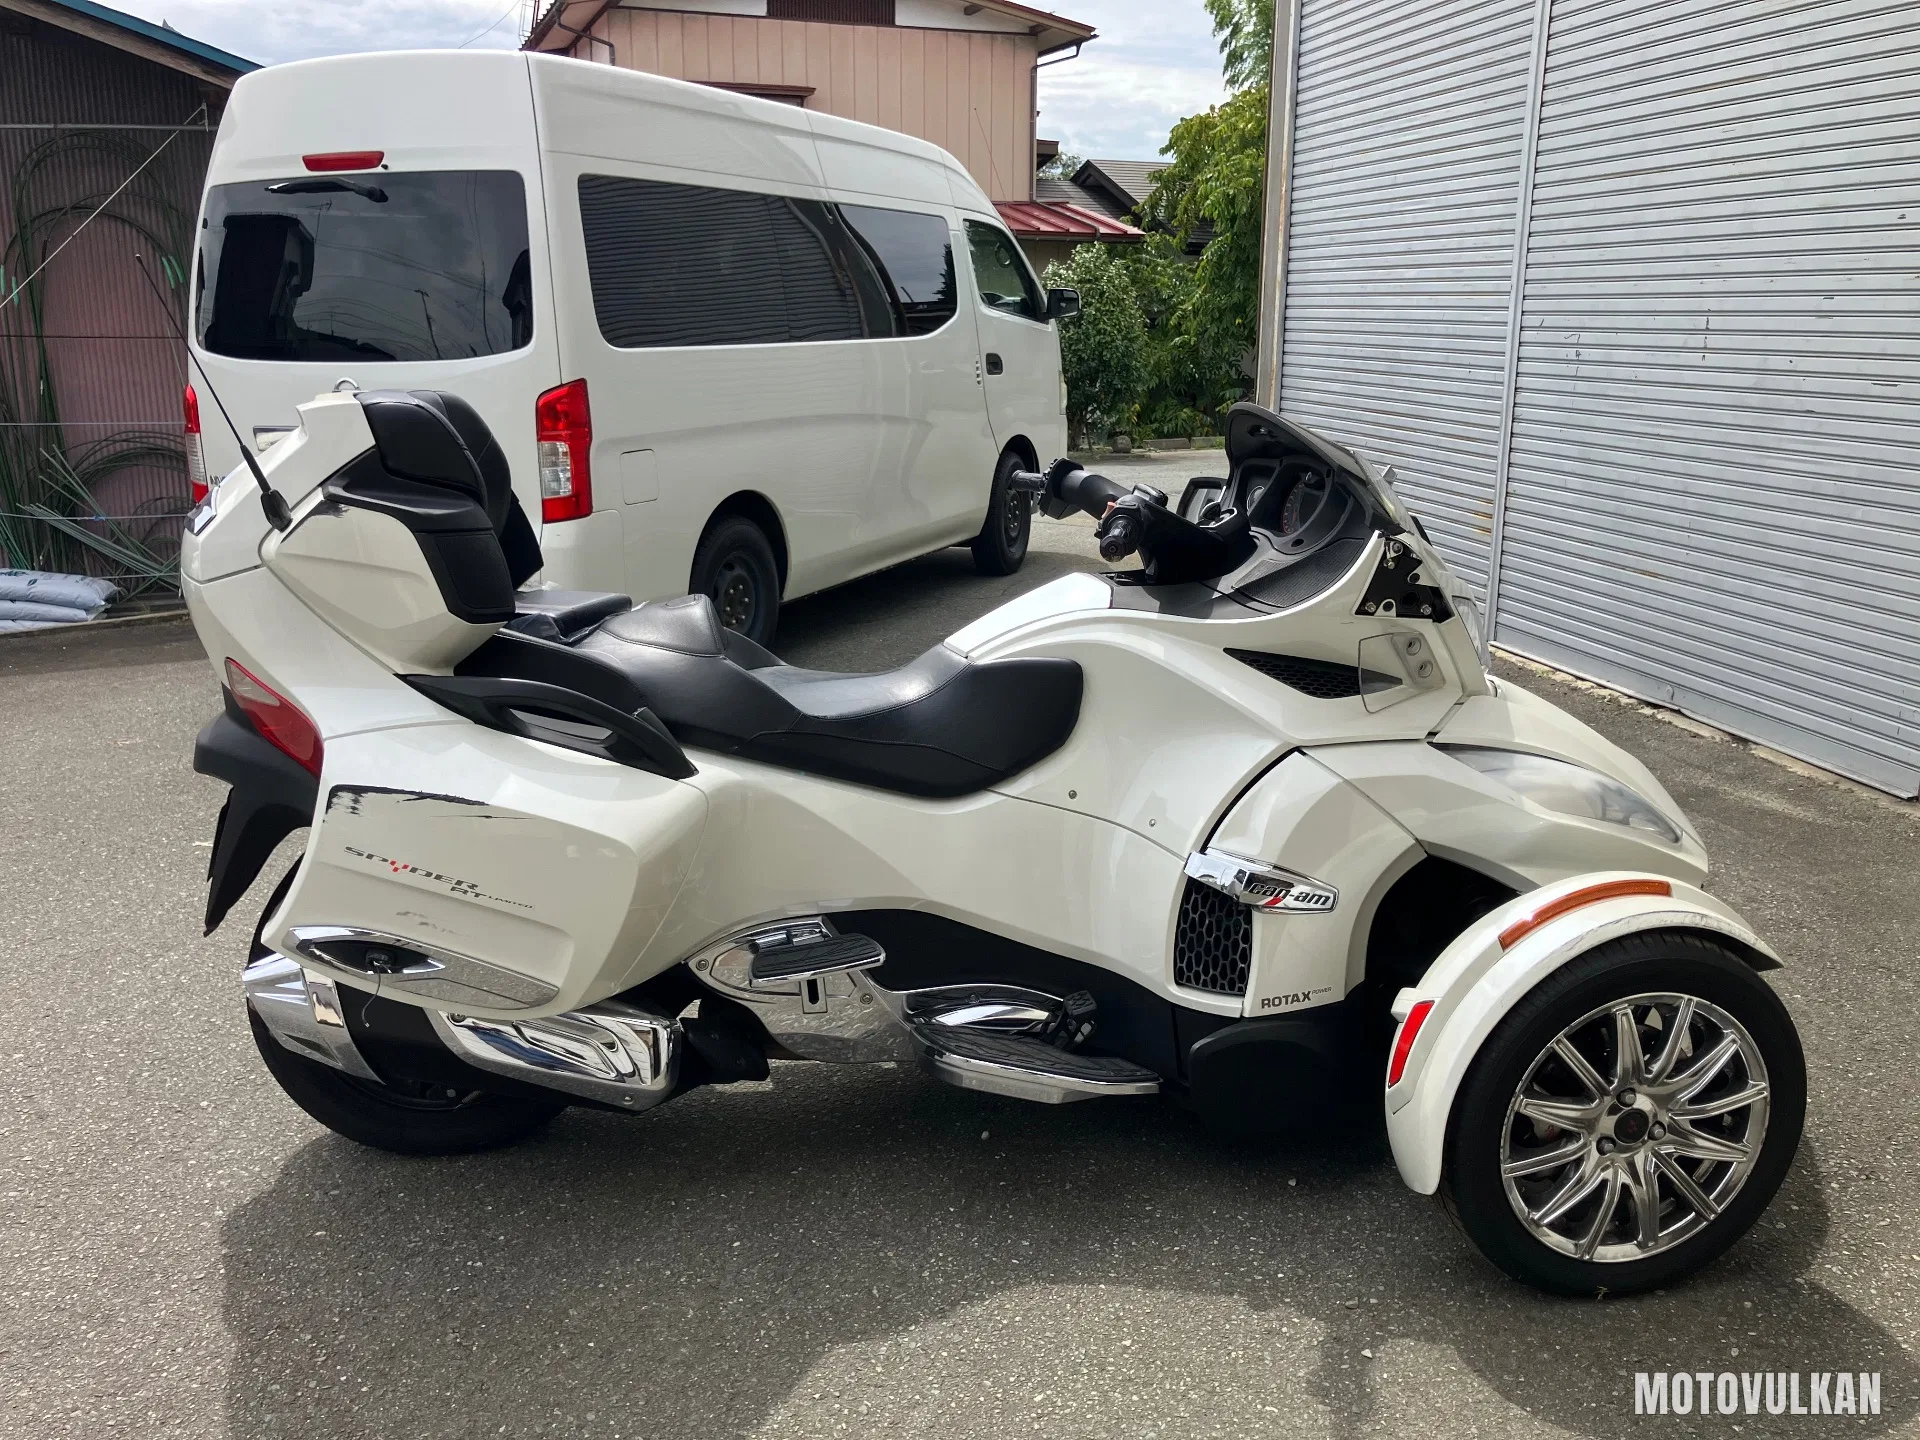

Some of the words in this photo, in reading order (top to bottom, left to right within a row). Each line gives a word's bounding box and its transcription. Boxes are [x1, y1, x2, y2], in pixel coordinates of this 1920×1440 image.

[343, 846, 479, 891] SPYDER
[450, 886, 487, 899] RT
[488, 895, 534, 909] LIMITED
[1247, 882, 1331, 906] can-am
[1261, 991, 1312, 1009] ROTAX
[1311, 986, 1332, 996] POWER
